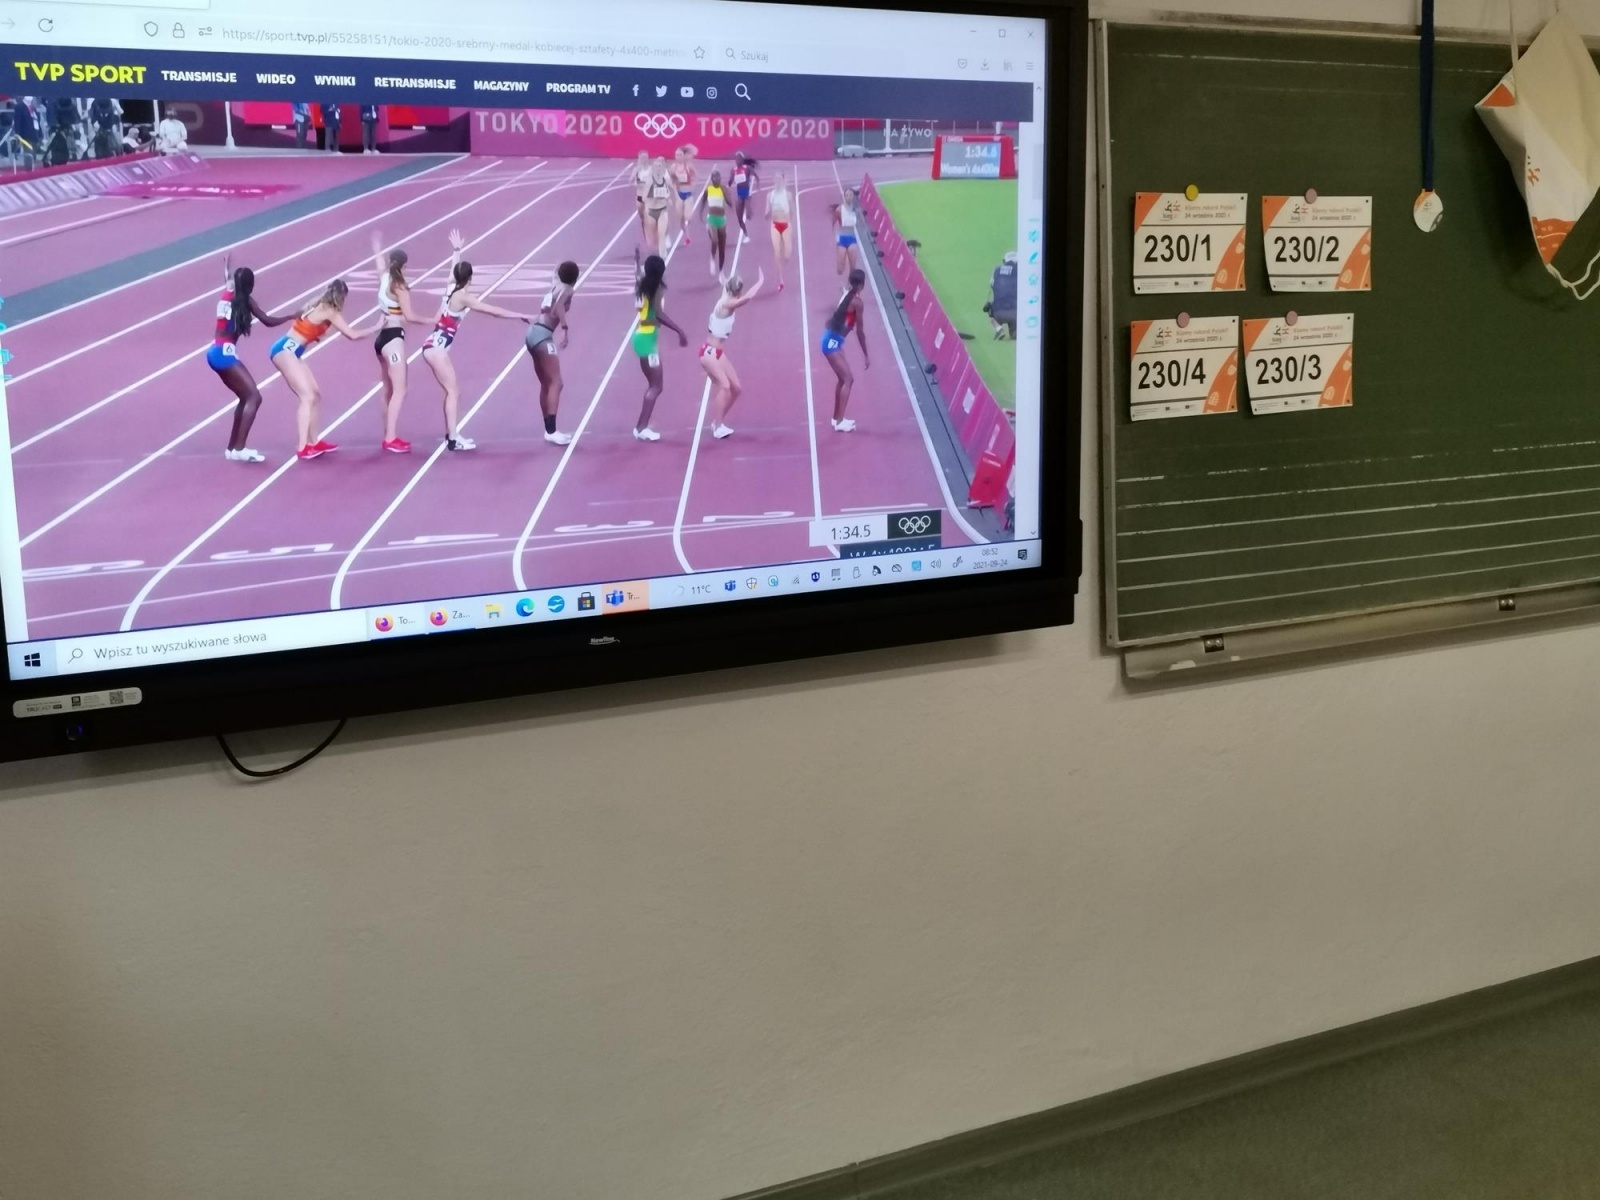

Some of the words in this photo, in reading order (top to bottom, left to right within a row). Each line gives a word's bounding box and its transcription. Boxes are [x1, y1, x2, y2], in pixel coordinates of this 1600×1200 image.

[741, 50, 768, 63] Szukaj
[14, 61, 64, 81] TVP
[71, 64, 147, 84] SPORT
[161, 70, 237, 83] TRANSMISJE
[256, 73, 296, 85] WIDEO
[314, 75, 356, 87] WYNIKI
[374, 77, 456, 90] RETRANSMISJE
[473, 80, 529, 92] MAGAZYNY
[546, 82, 596, 94] PROGRAM
[598, 84, 611, 95] TV
[475, 111, 558, 134] TOKYO
[565, 114, 622, 136] 2020
[697, 117, 771, 138] TOKYO
[776, 118, 830, 139] 2020
[1144, 233, 1211, 263] 230/1
[1273, 236, 1340, 263] 230/2
[1138, 357, 1206, 389] 230/4
[1255, 354, 1322, 385] 230/3
[831, 524, 872, 541] 1:34.5
[973, 559, 1008, 570] 2021-09-24
[691, 584, 711, 594] 11°C
[94, 645, 132, 660] Wpisz
[136, 645, 148, 655] tu
[152, 637, 229, 654] wyszukiwane
[233, 632, 267, 645] słowa
